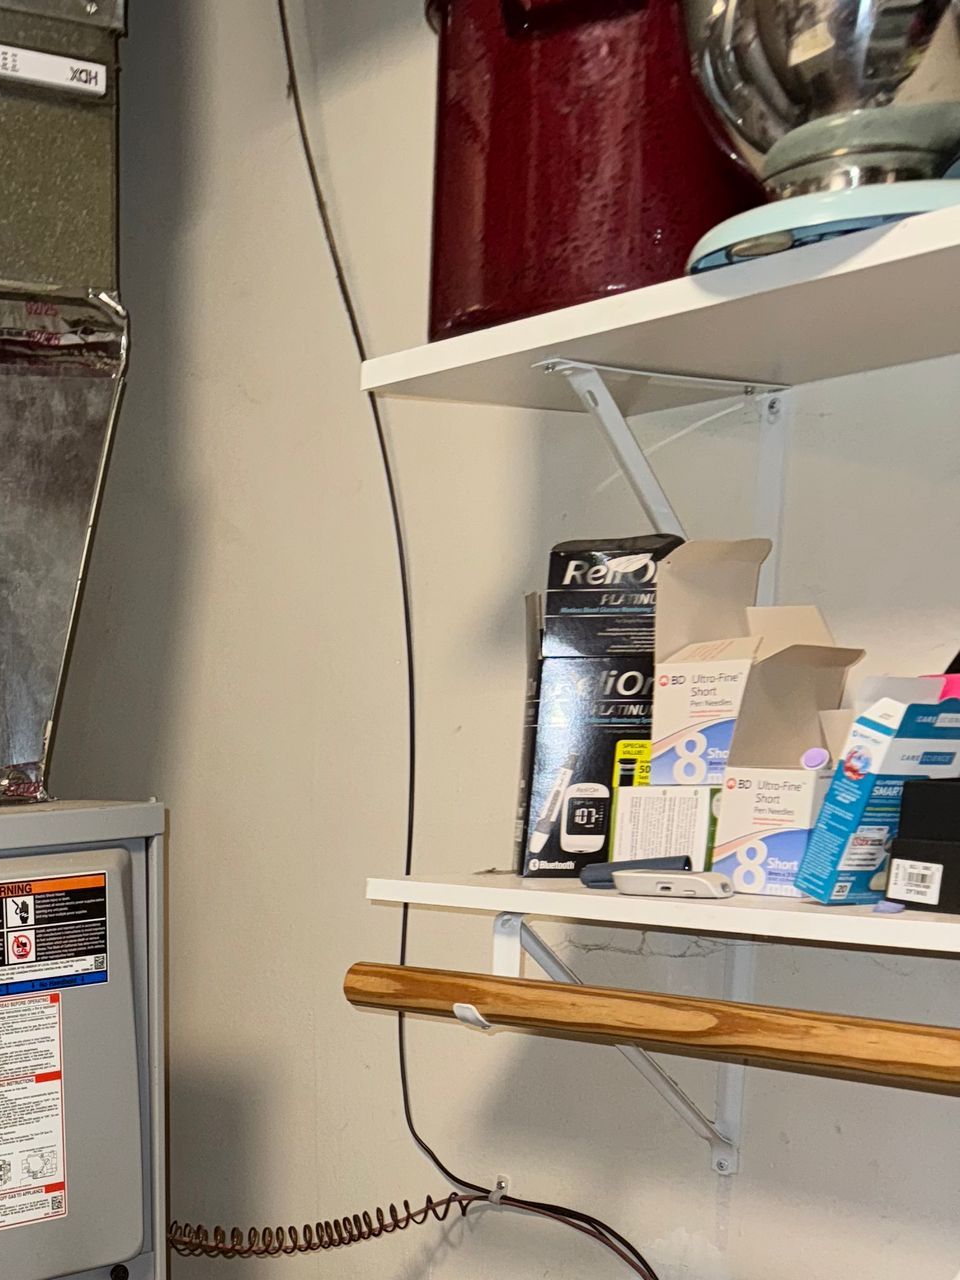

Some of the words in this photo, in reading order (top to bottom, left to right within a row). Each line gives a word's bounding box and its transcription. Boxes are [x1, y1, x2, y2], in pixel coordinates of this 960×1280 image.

[69, 66, 99, 87] HDX
[562, 560, 657, 585] ReliO
[671, 676, 686, 685] BD
[691, 687, 717, 697] Short
[672, 732, 707, 785] 8
[639, 765, 651, 773] 50
[738, 780, 752, 789] BD
[755, 793, 780, 804] Short
[540, 861, 575, 870] Bluetooth
[732, 840, 768, 893] 8
[767, 857, 798, 870] Short
[27, 997, 49, 1005] OPERATING
[6, 1078, 34, 1086] INSTRUCTIONS
[23, 1188, 43, 1196] APPLIANCE
